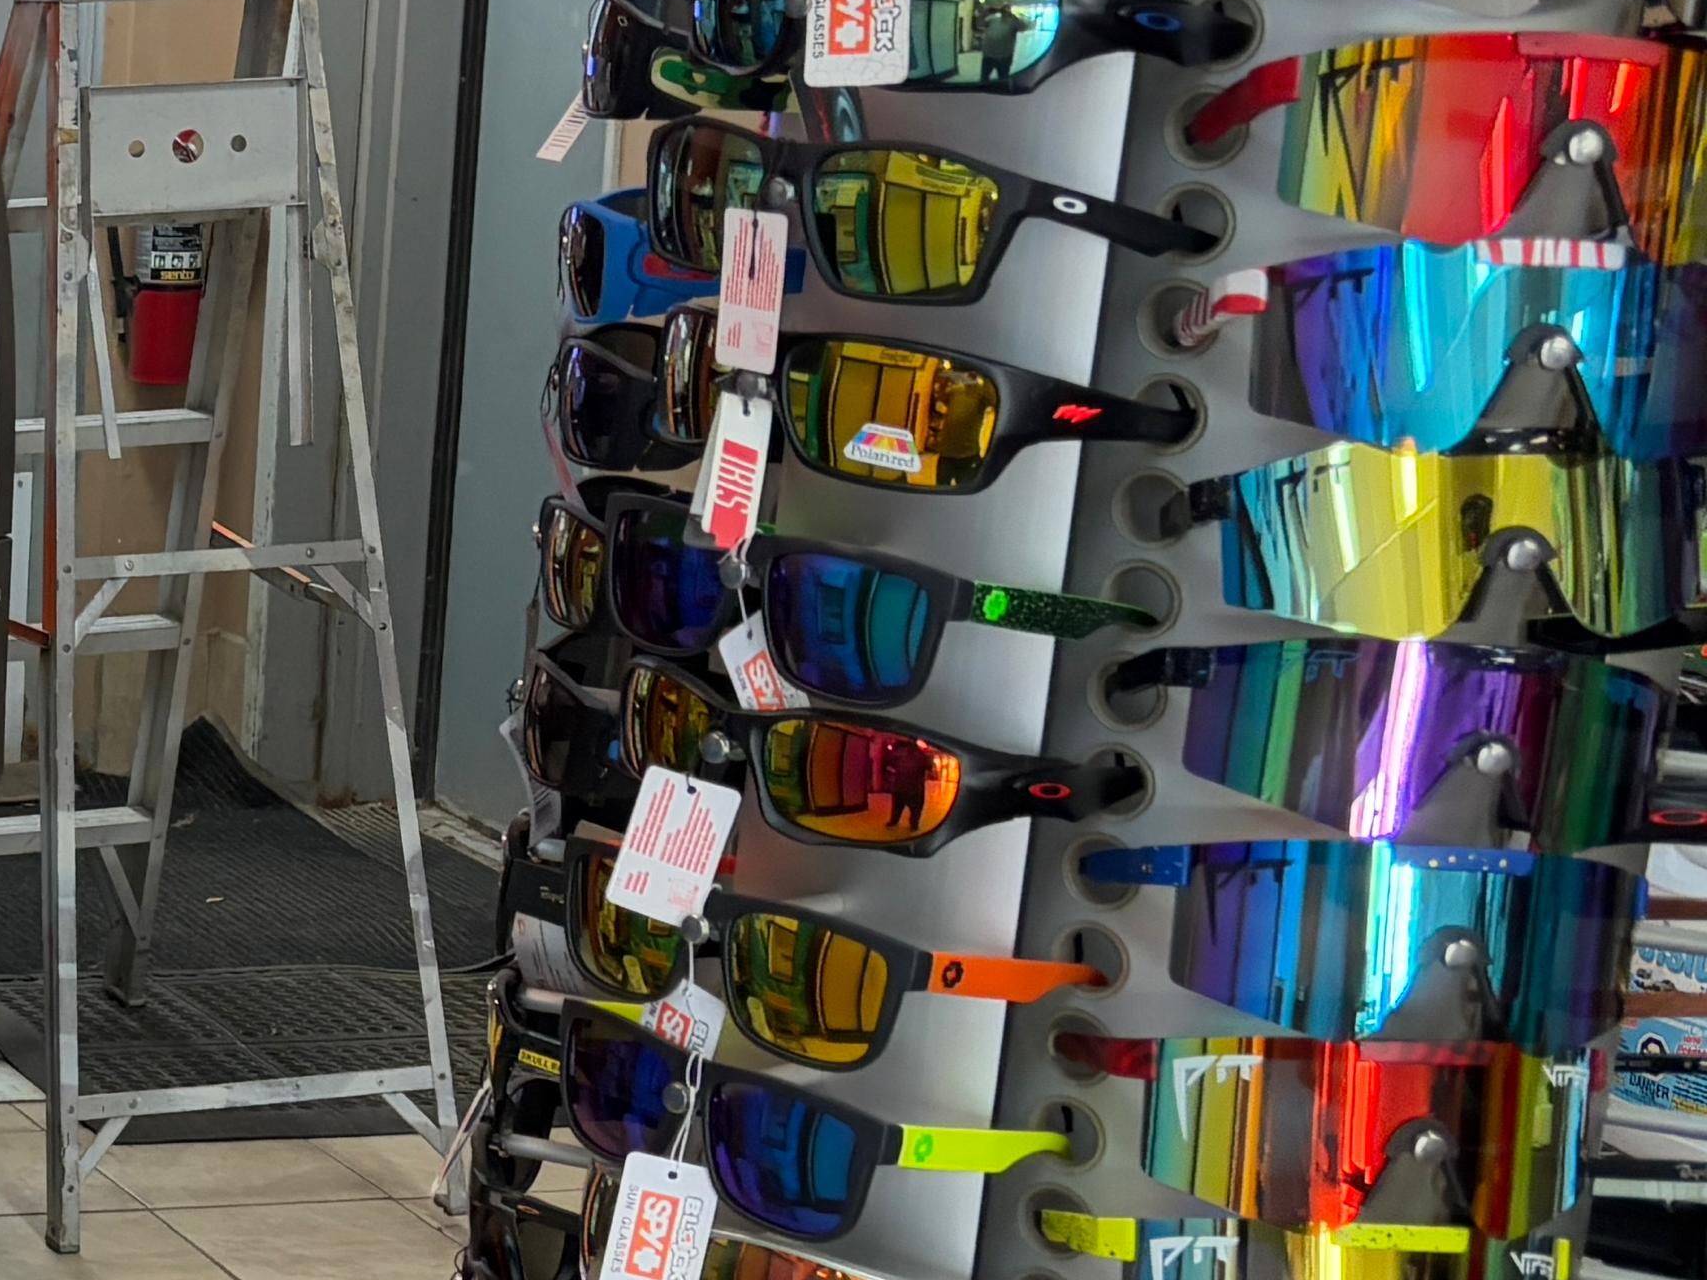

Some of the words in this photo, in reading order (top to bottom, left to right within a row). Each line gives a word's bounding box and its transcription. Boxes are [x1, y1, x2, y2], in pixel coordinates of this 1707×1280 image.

[851, 444, 915, 468] Polarized
[714, 453, 757, 517] IRIS
[1629, 1073, 1670, 1099] DANGER
[625, 1184, 639, 1209] SUN
[611, 1217, 631, 1272] GLASSES
